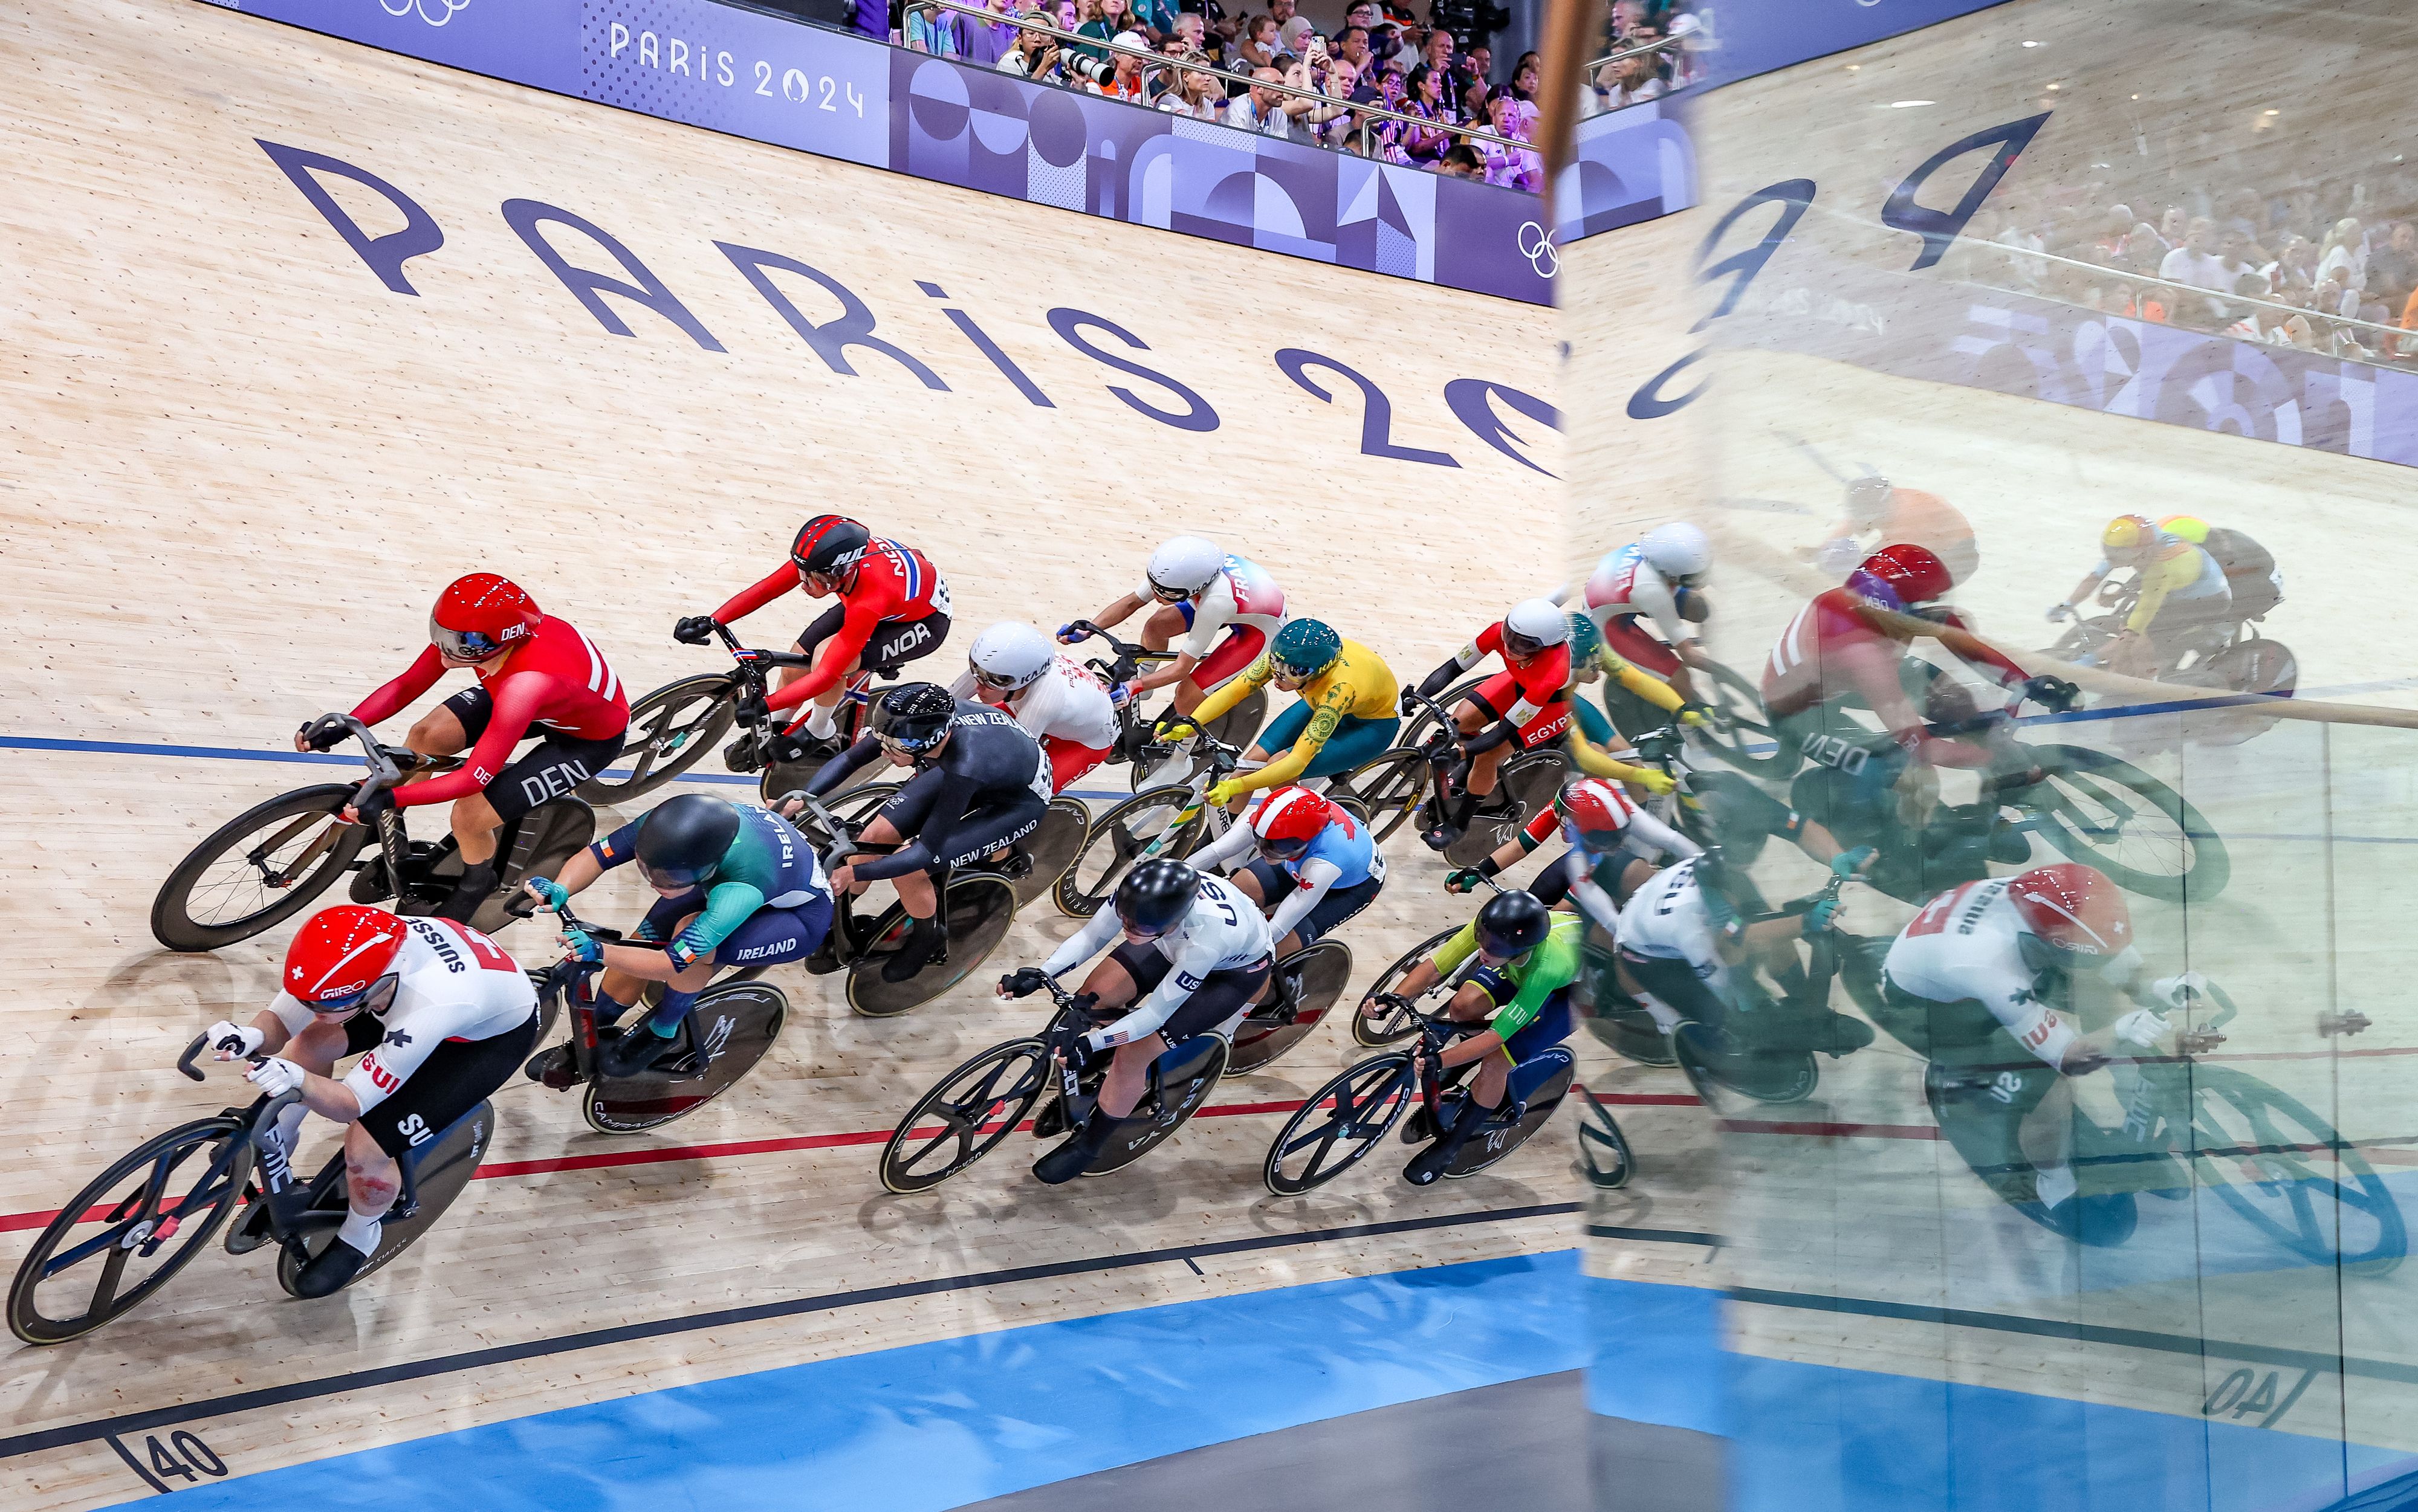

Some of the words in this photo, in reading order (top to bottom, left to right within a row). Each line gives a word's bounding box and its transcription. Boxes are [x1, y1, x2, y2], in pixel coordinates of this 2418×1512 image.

[501, 622, 525, 641] DEN
[881, 622, 932, 662] NOR
[957, 714, 988, 726] NEW
[1526, 711, 1574, 745] EGYPT
[520, 760, 591, 807] DEN
[950, 851, 979, 869] NEW
[982, 819, 1037, 857] ZEALAND
[737, 937, 797, 961] IRELAND
[1508, 1004, 1528, 1025] LTU
[362, 1053, 401, 1095] SUI
[398, 1113, 434, 1147] SU
[146, 1430, 229, 1483] 40
